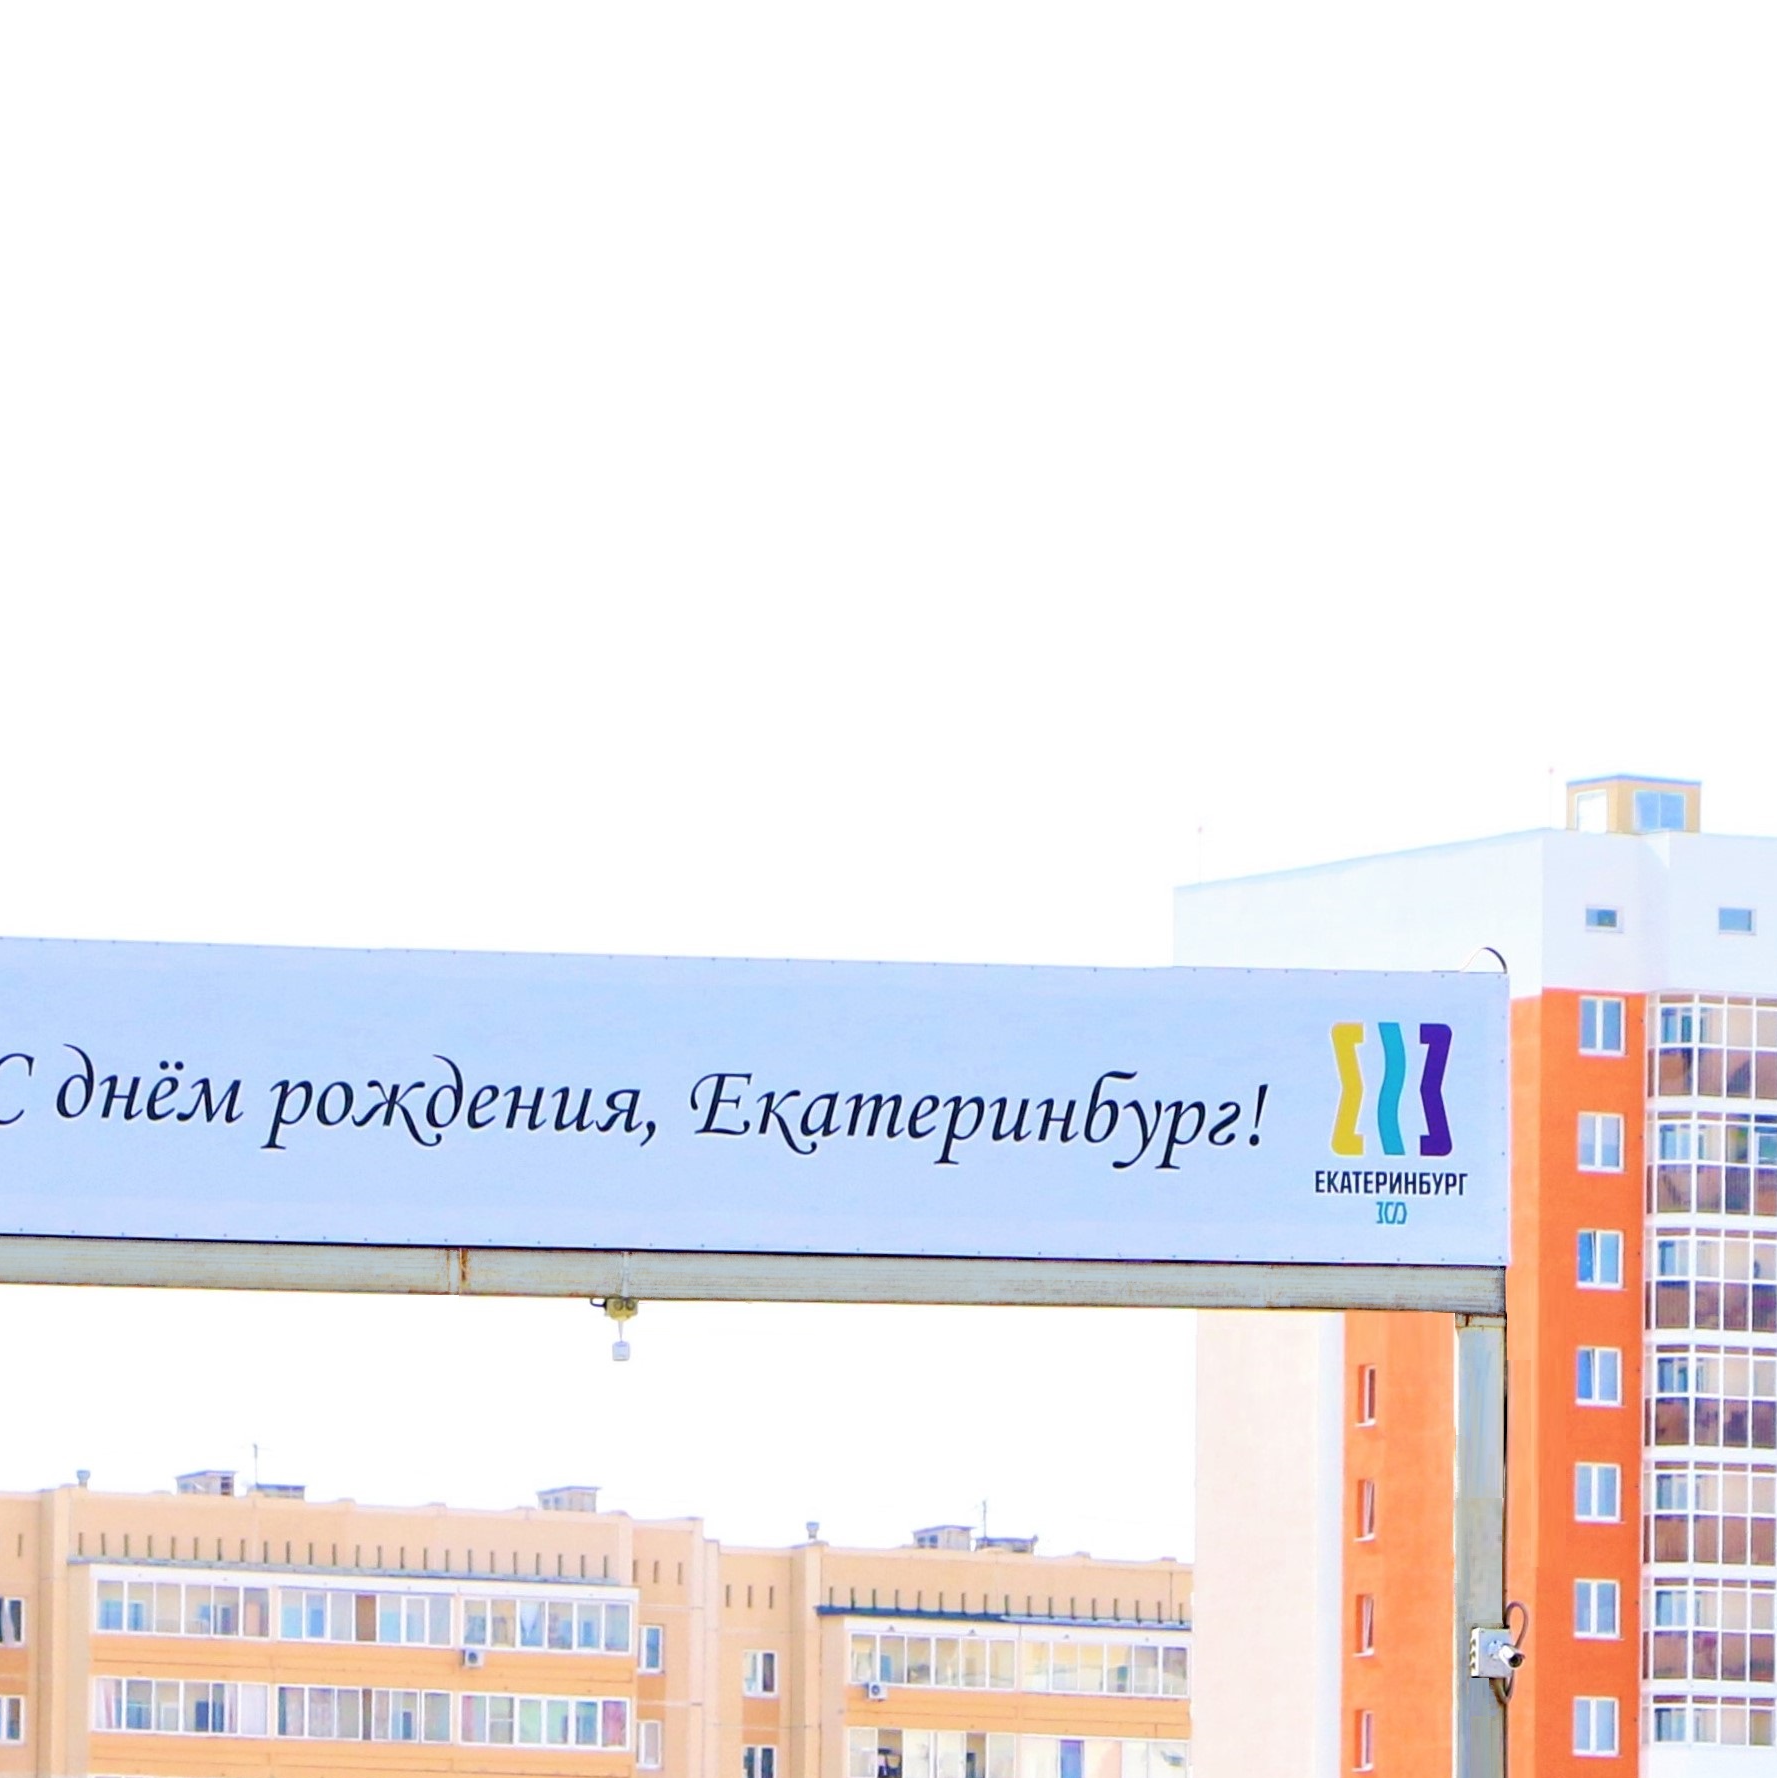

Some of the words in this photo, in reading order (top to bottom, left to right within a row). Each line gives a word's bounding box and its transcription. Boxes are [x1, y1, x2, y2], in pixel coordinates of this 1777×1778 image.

[55, 1043, 244, 1124] днём
[260, 1054, 658, 1150] рождения,
[689, 1070, 1269, 1171] Екатеринбург!
[1315, 1171, 1469, 1196] ЕКАТЕРИНБУРГ
